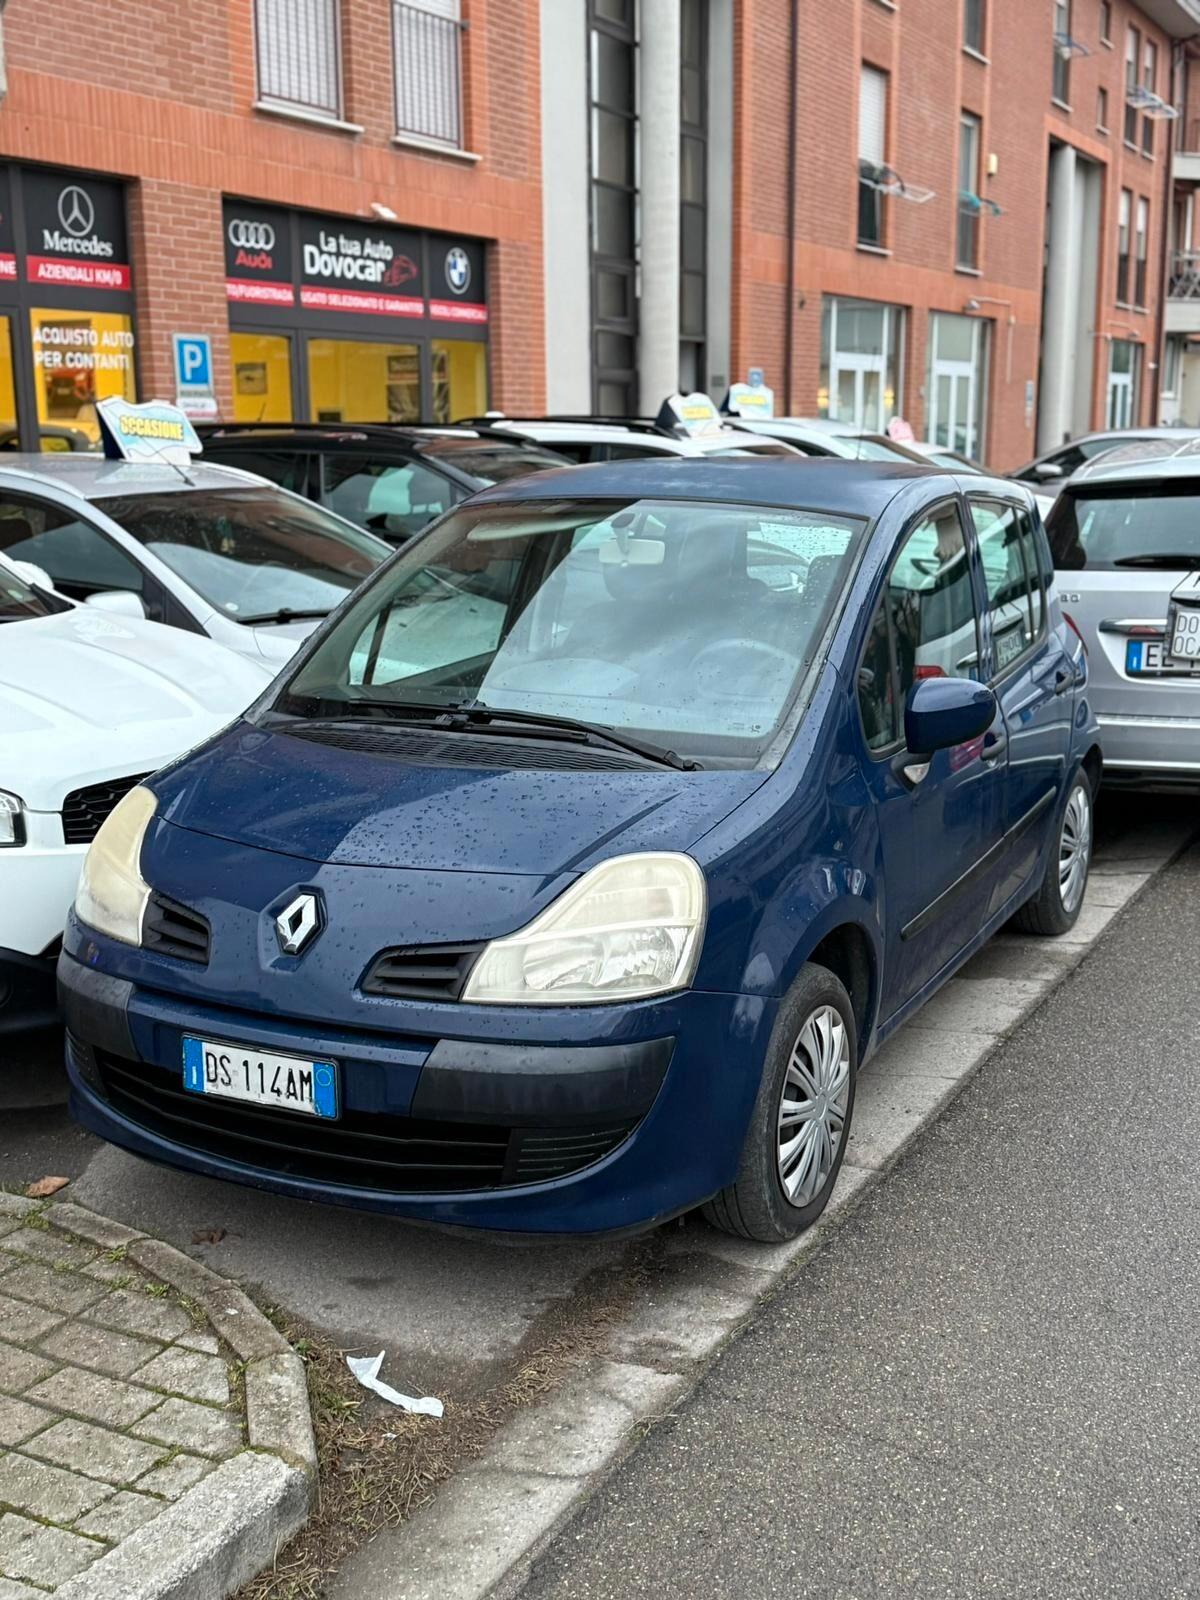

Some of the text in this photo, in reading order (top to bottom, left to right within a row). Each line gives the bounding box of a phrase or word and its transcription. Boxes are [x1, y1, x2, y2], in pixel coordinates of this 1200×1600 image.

[42, 229, 114, 257] Mercedes
[320, 230, 394, 261] La tua Auto
[235, 250, 273, 269] Audi
[38, 262, 94, 283] AZIENDALI
[33, 326, 134, 348] ACQUISTO AUTO
[34, 350, 130, 370] PER CONTANTI
[183, 344, 202, 380] P
[120, 415, 184, 441] OCCASIONE
[1173, 636, 1200, 655] OC
